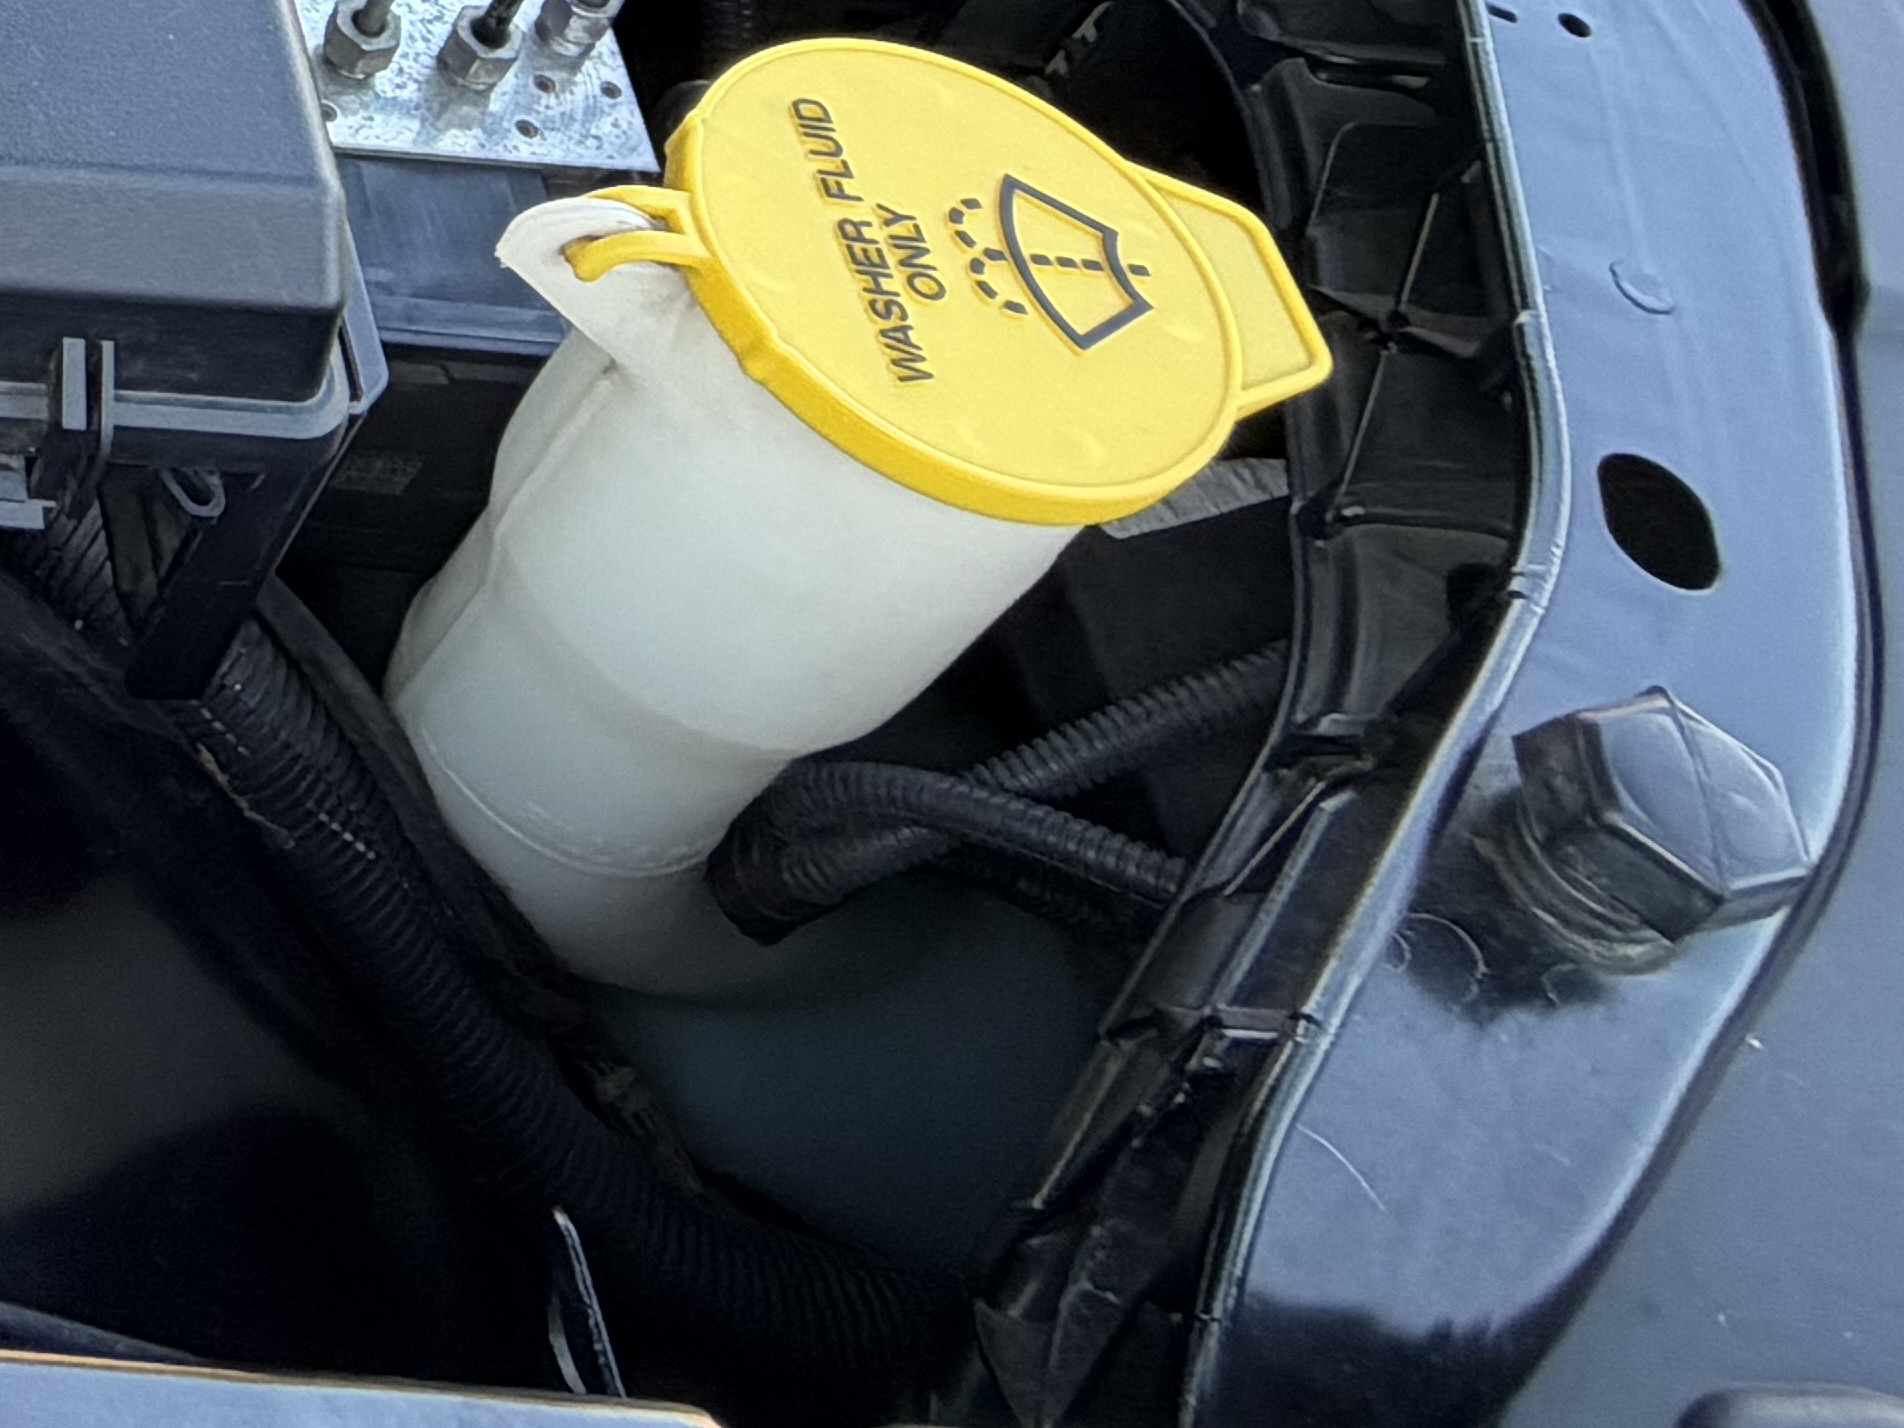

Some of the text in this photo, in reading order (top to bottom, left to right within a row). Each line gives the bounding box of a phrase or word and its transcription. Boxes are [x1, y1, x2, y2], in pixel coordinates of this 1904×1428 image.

[791, 98, 935, 383] WASHER FLUID
[874, 203, 946, 301] ONLY
